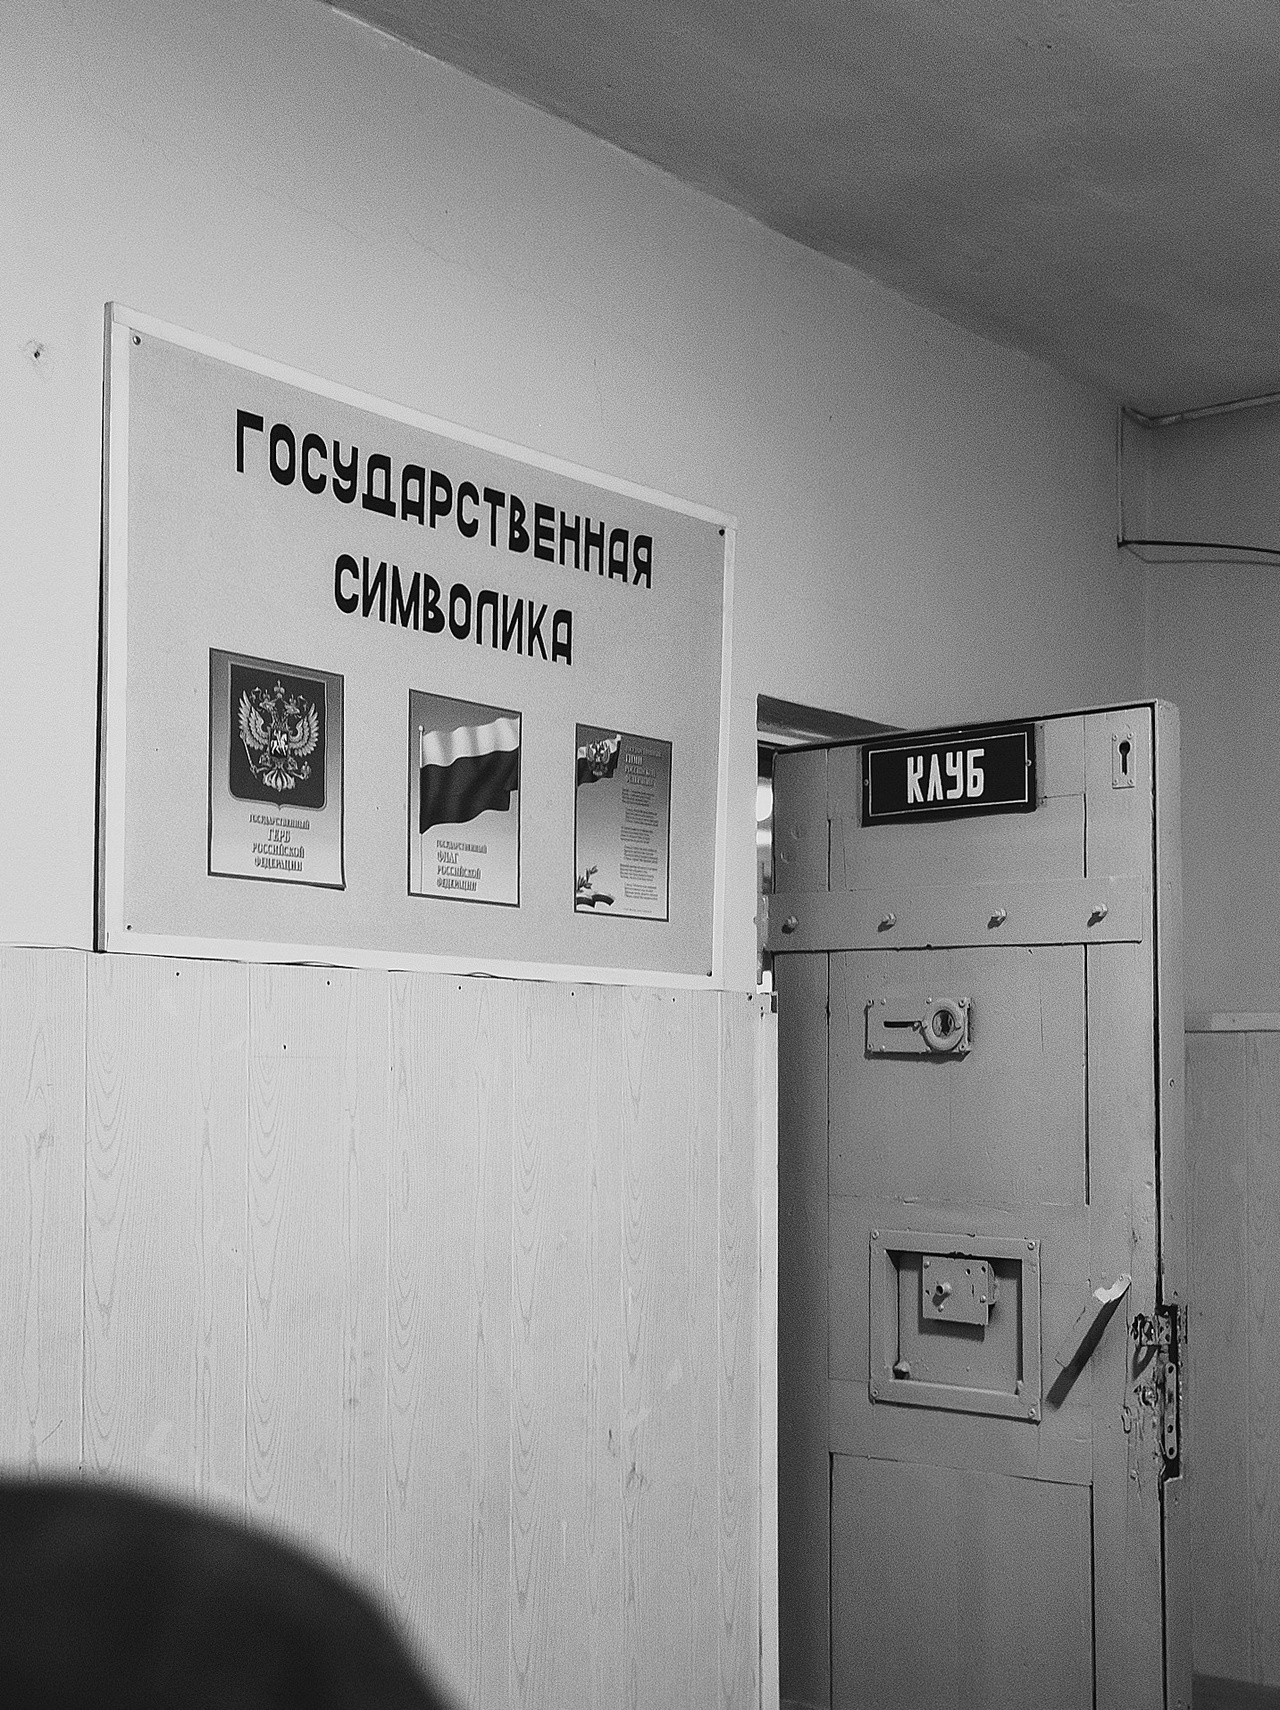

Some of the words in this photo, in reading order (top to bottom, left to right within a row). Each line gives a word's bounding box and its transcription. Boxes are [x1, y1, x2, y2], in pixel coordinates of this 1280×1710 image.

[236, 408, 652, 589] ГОСУДАРСТВЕННАЯ
[334, 554, 572, 665] СИМВОЛИКА
[907, 748, 985, 804] КЛУБ
[268, 829, 291, 844] ГЕРБ
[252, 843, 305, 859] РОССИЙСКОЙ
[437, 850, 459, 864] ФЛАГ
[254, 856, 303, 872] ФЕДЕРАЦИИ
